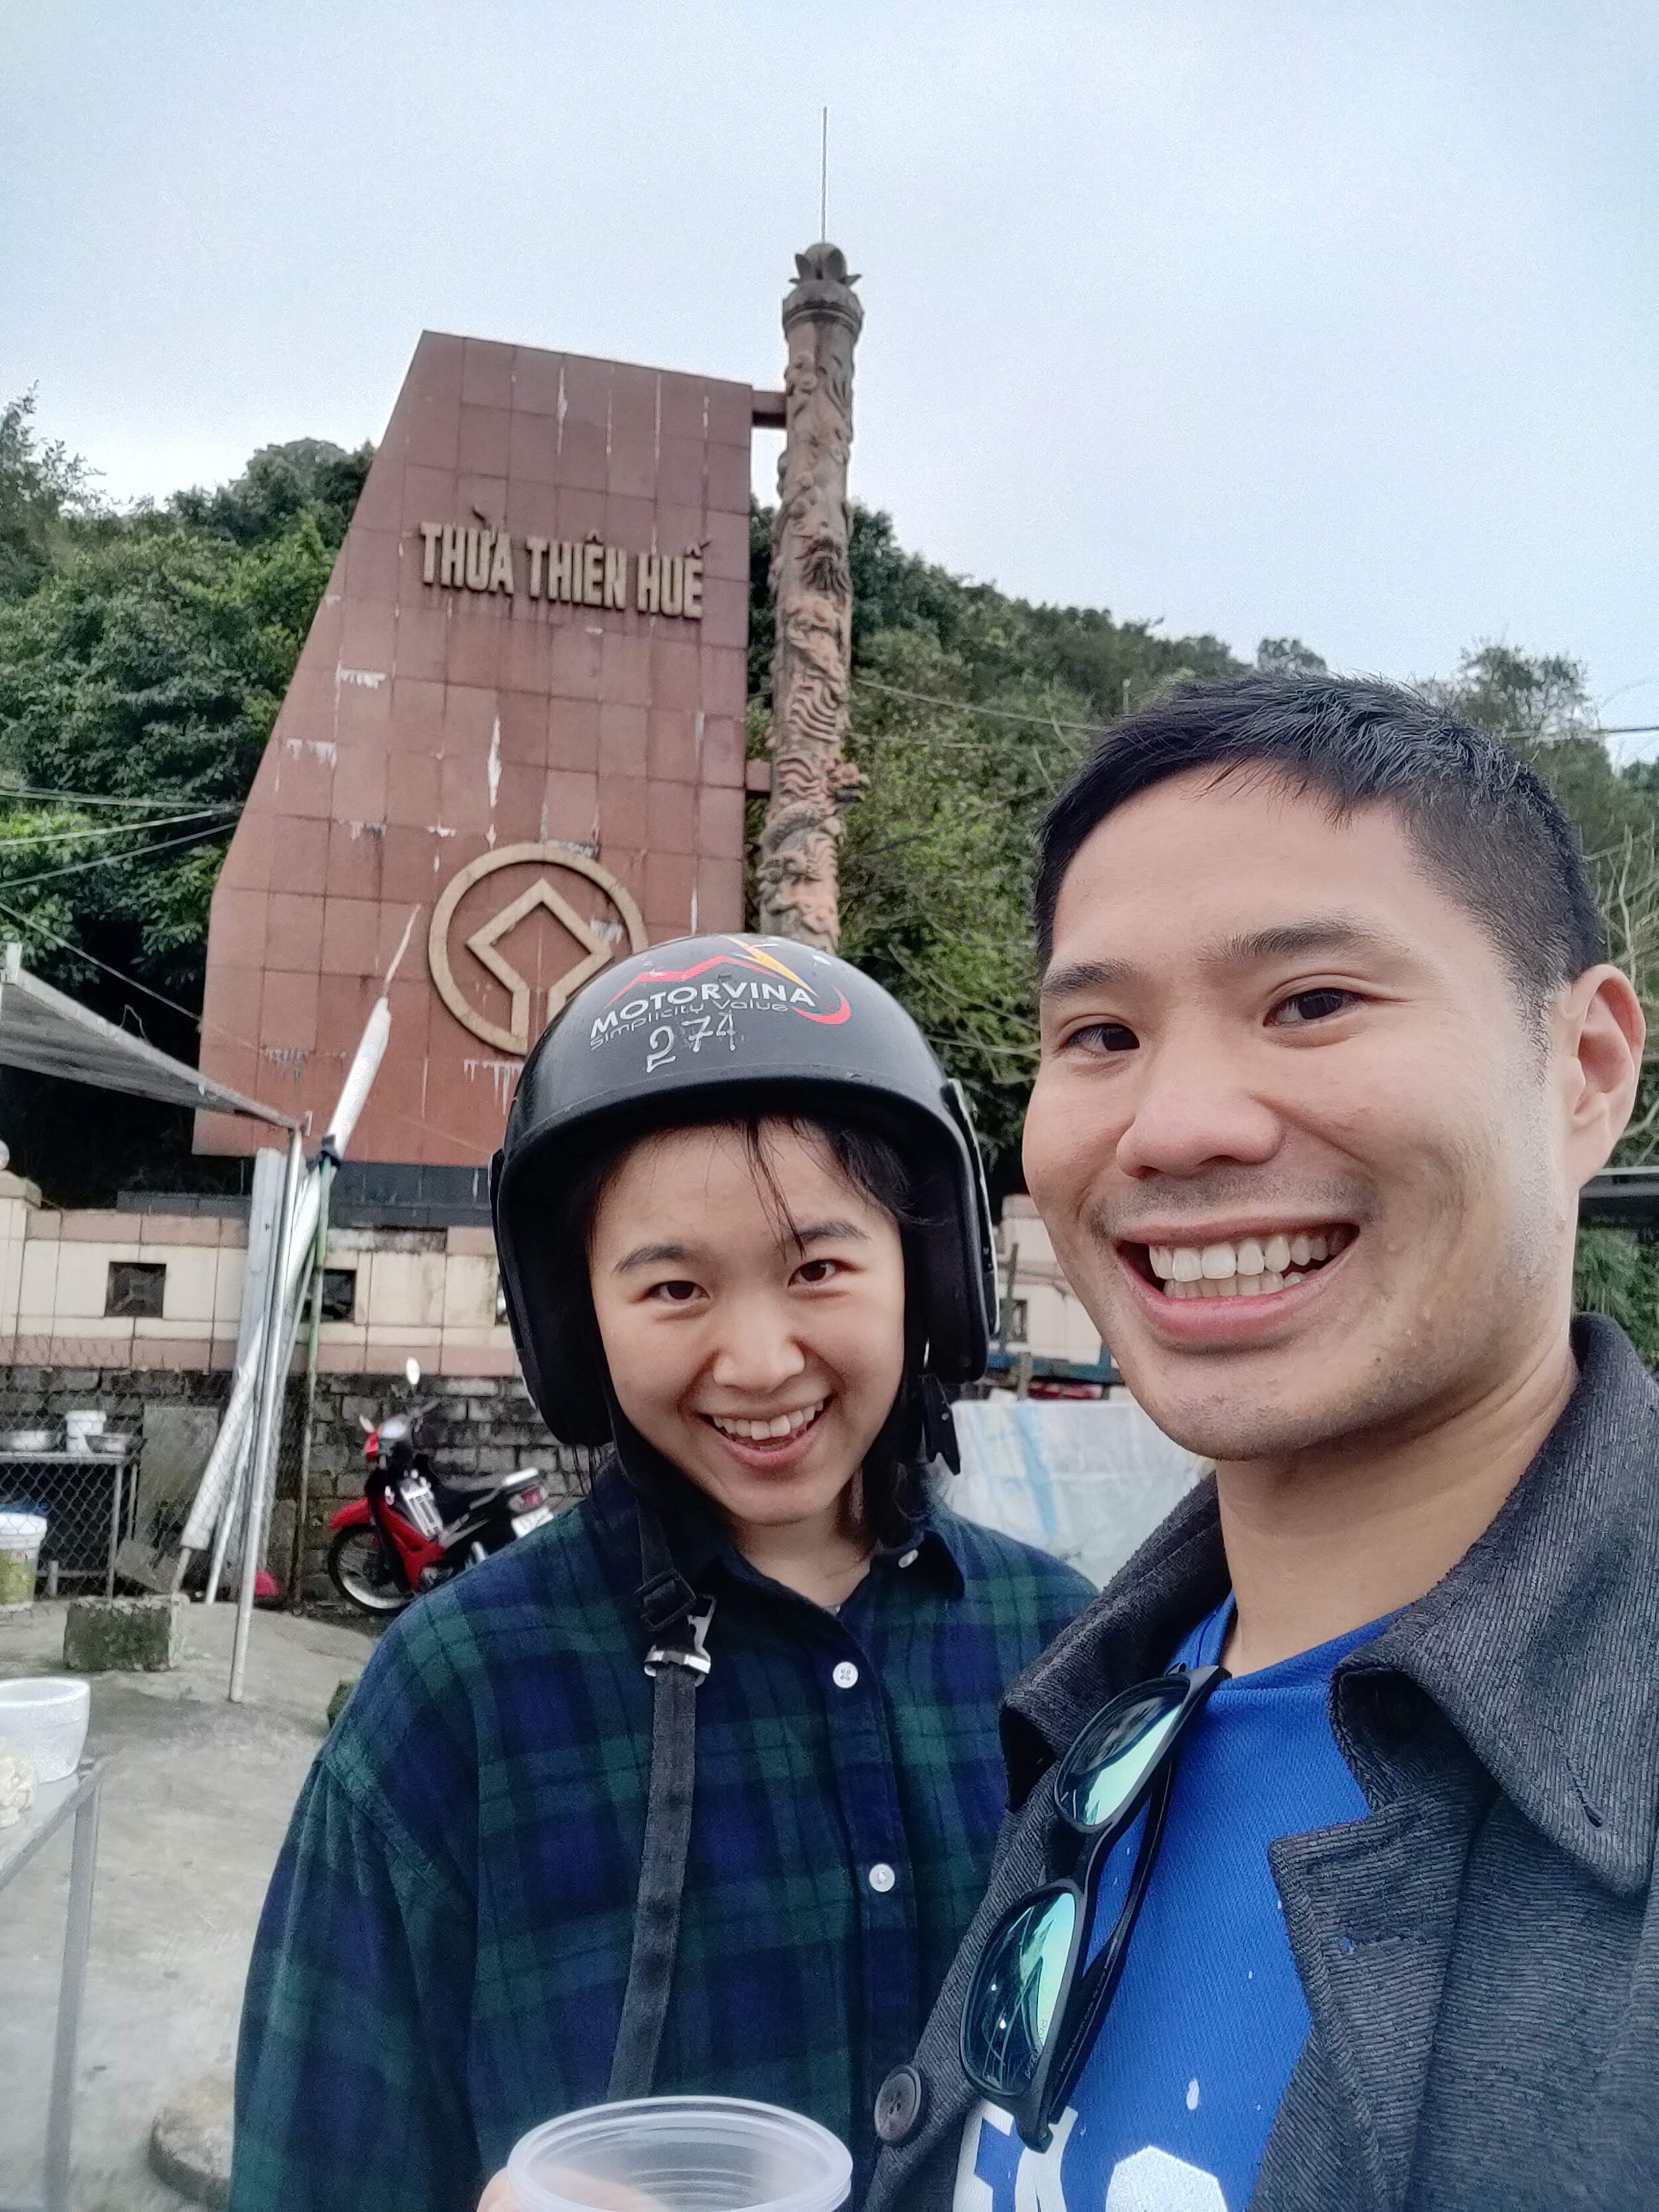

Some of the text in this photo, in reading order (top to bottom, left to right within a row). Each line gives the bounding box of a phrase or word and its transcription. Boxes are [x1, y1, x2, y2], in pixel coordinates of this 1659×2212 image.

[419, 507, 712, 620] THỪA THIÊN HUẾ
[591, 982, 816, 1039] MOTORVINA
[646, 1009, 736, 1073] 274
